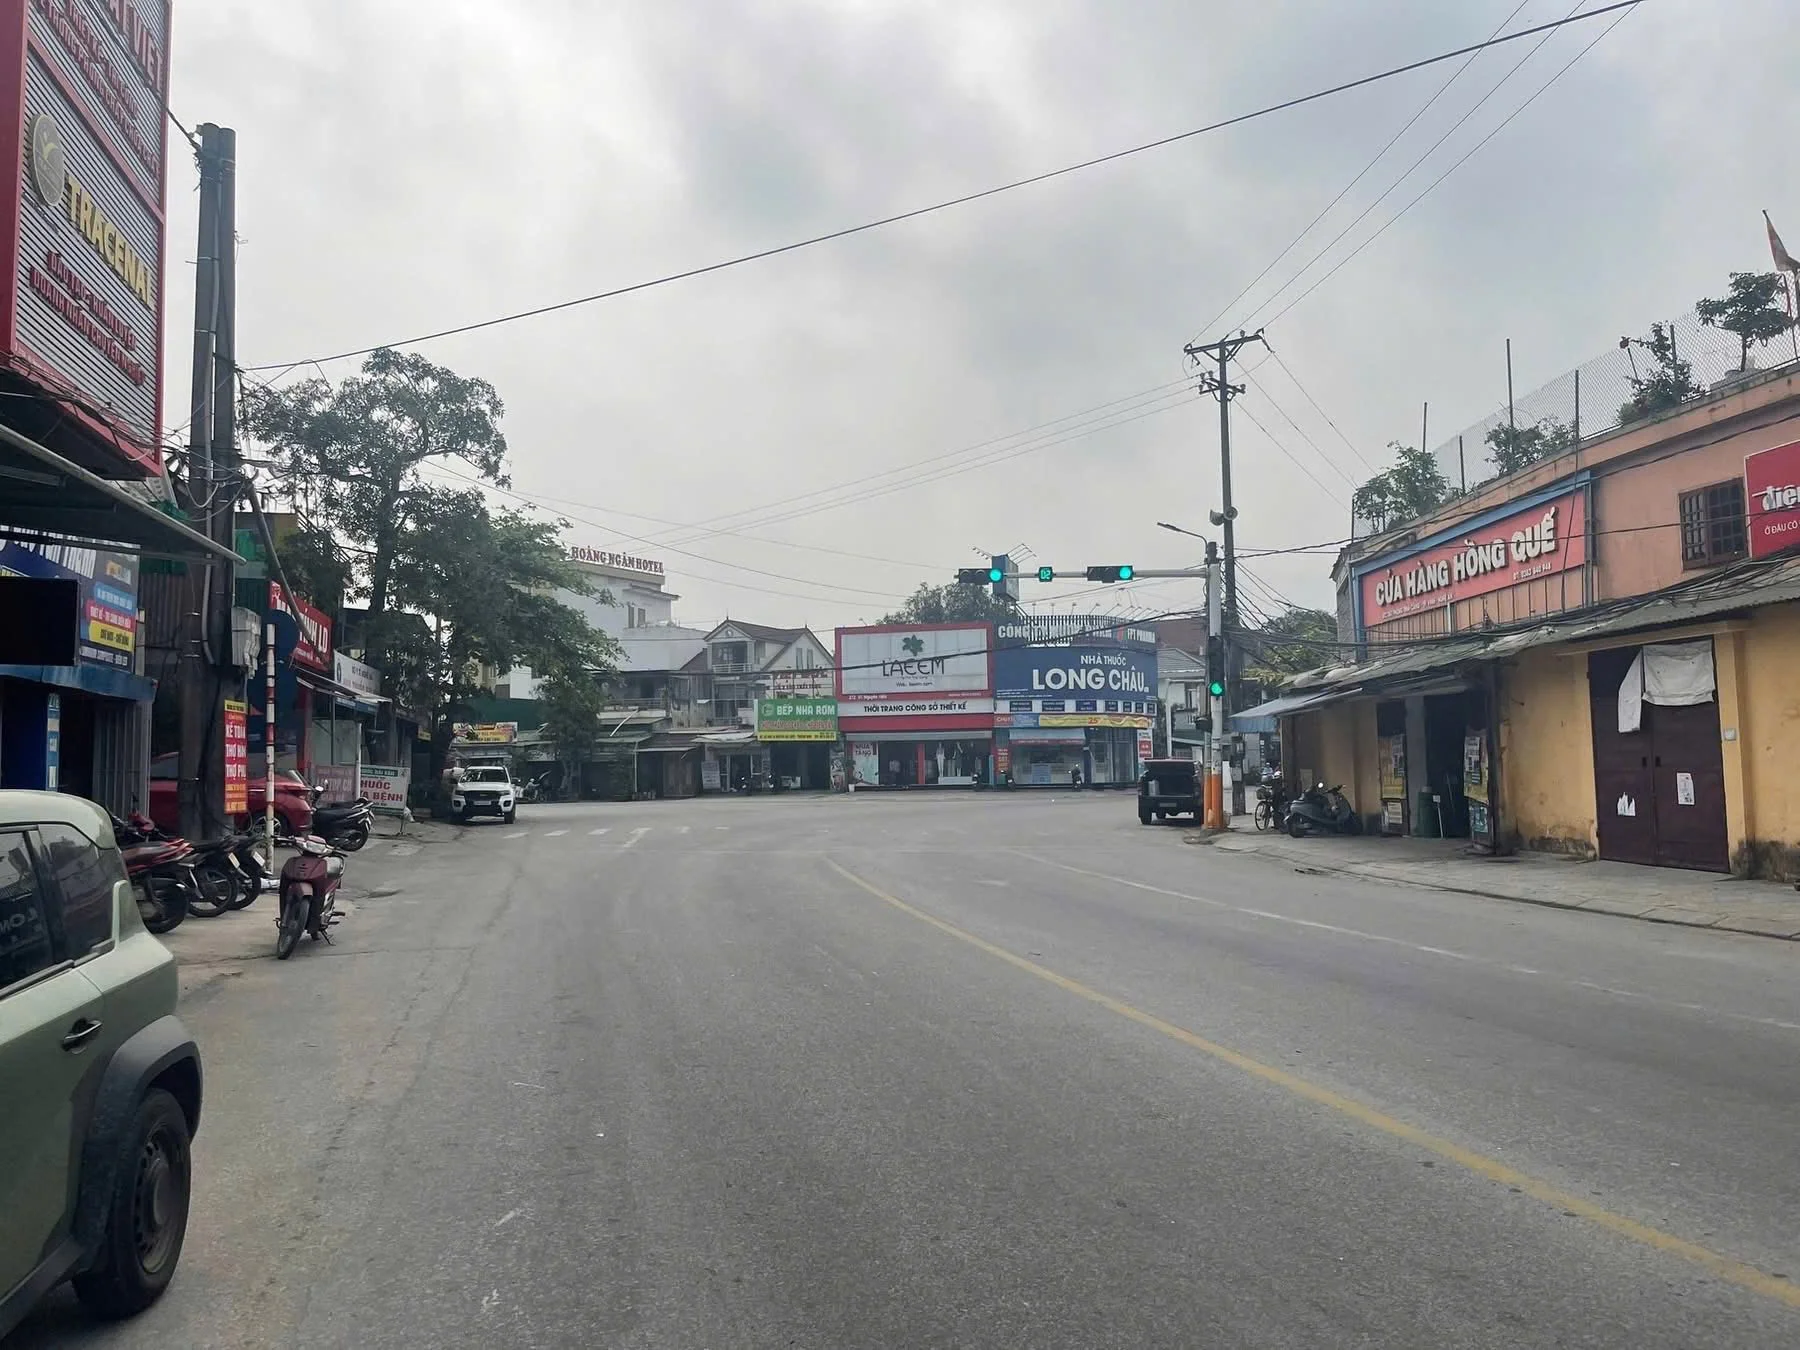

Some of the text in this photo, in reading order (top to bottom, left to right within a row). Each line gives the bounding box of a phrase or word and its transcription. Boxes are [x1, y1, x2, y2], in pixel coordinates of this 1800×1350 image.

[1376, 505, 1558, 607] CỬA HÀNG HỒNG QUẾ
[635, 558, 664, 574] HOTEL
[998, 622, 1028, 638] CÔNG
[1128, 628, 1136, 641] FPT
[882, 658, 945, 677] LAEEM
[1080, 652, 1127, 666] NHÀ THUỐC
[1032, 668, 1105, 690] LONG
[776, 703, 793, 716] BẾP
[795, 702, 813, 715] NHÀ
[864, 700, 967, 713] THỜI TRANG CÔNG SỞ THIẾT KẾ
